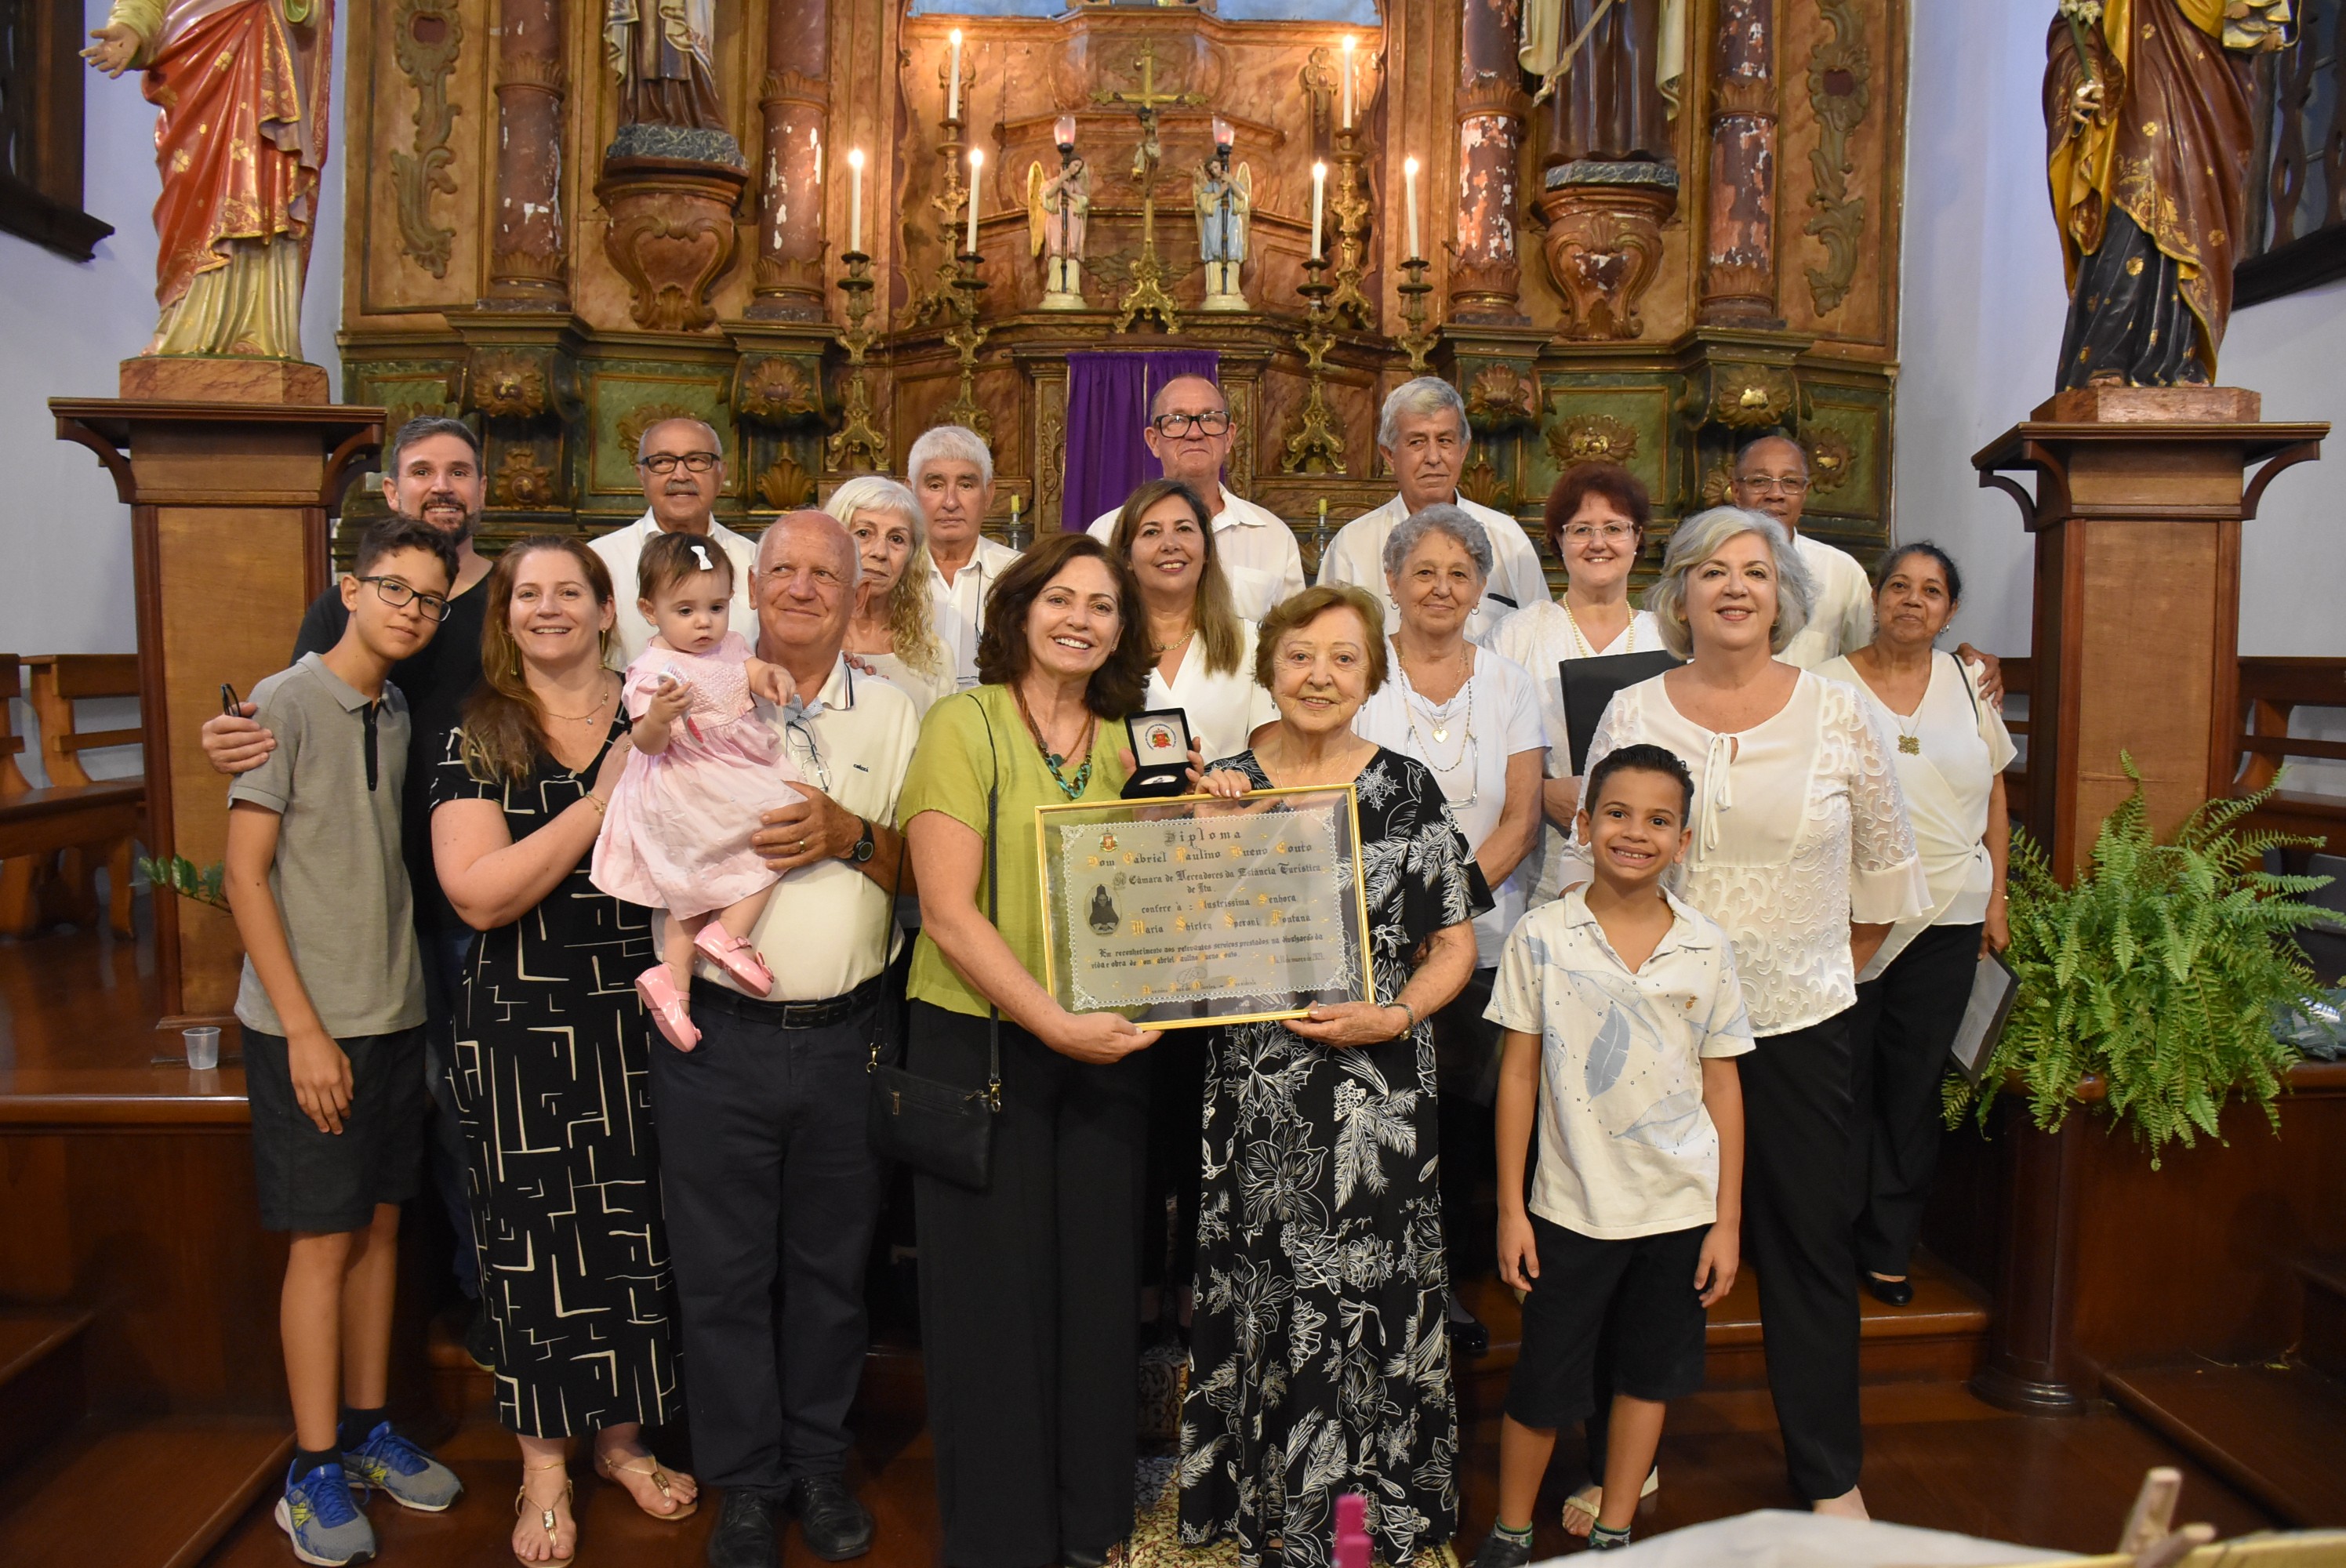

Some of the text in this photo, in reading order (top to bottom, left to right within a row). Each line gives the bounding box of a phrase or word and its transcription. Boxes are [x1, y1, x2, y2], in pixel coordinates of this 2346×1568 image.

[1164, 829, 1240, 848] Diploma
[1087, 841, 1312, 866] Dom Gabriel Paulino Bueno Couto
[1129, 875, 1162, 884] Câmara
[1176, 869, 1223, 881] Vereadores
[1142, 904, 1171, 913] confere
[1258, 894, 1296, 905] Senhora
[1131, 909, 1311, 935] Maria Shirley Speroni Fontana
[1099, 949, 1111, 957] Em
[1115, 947, 1162, 956] reconhecimento
